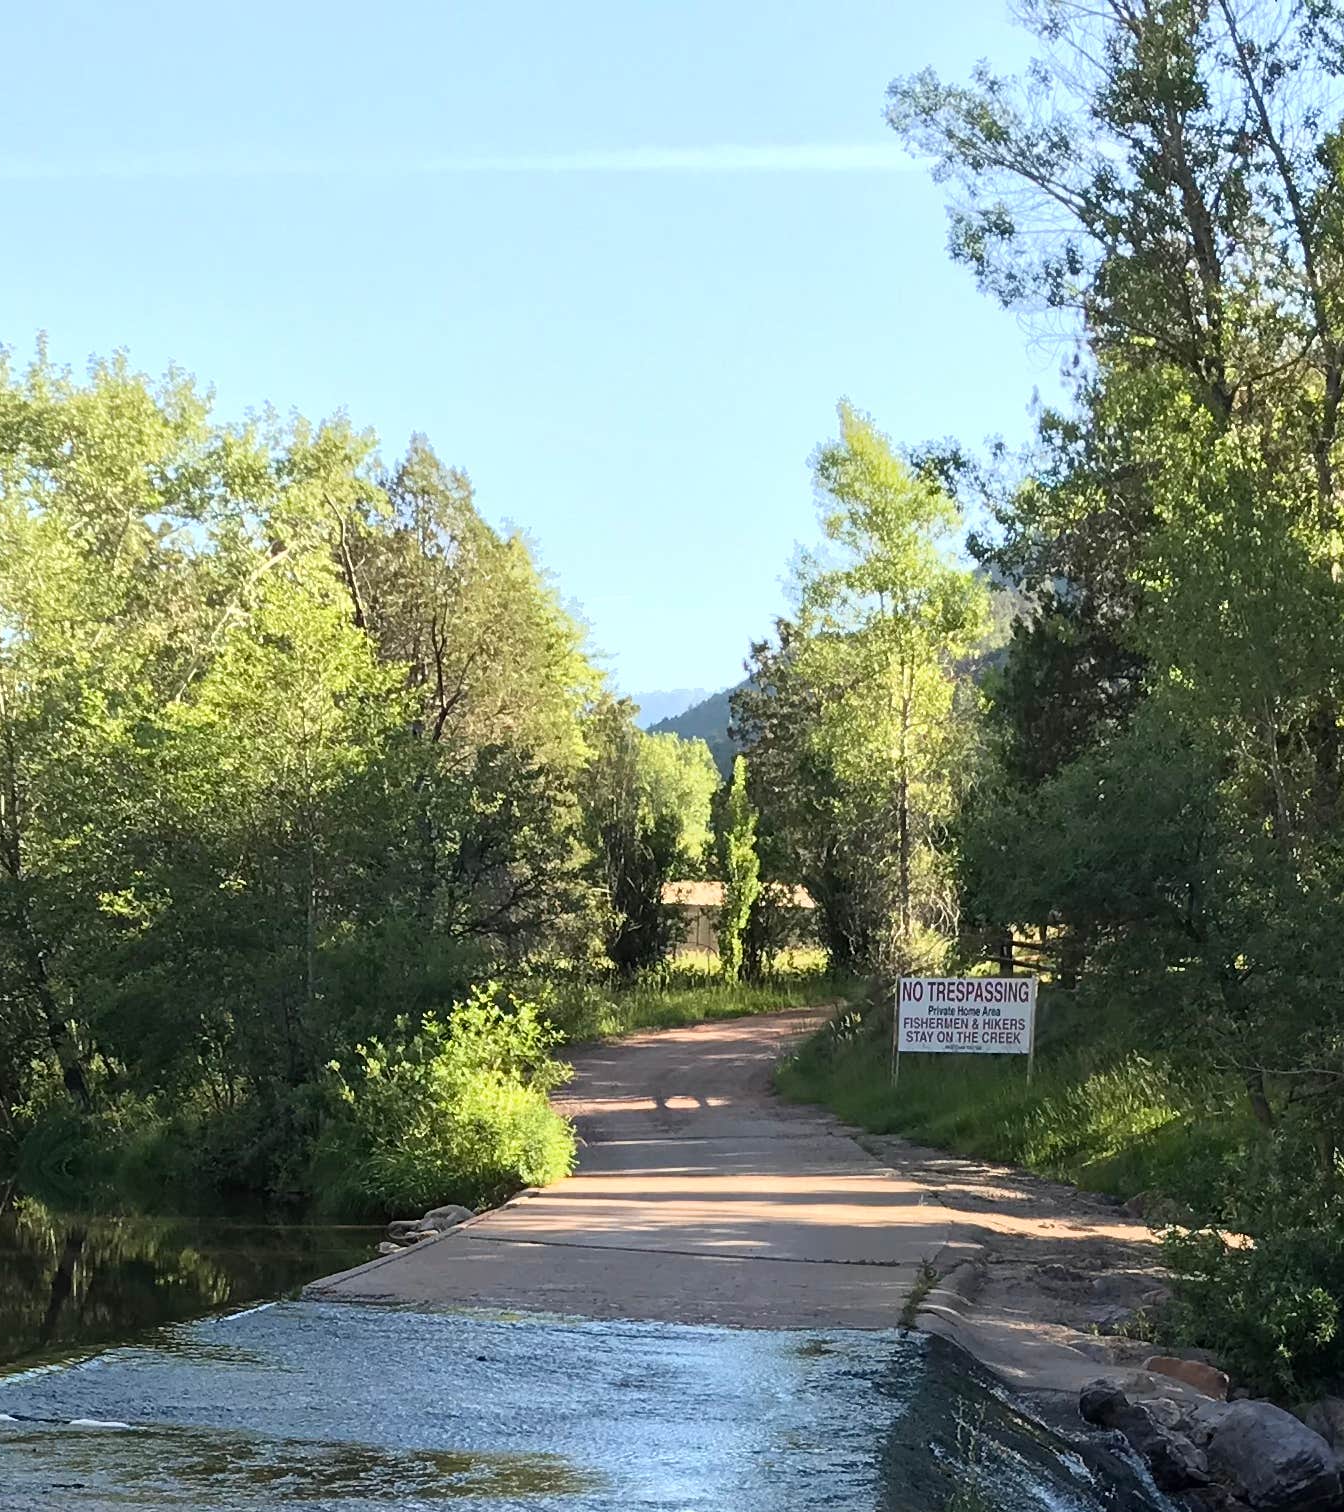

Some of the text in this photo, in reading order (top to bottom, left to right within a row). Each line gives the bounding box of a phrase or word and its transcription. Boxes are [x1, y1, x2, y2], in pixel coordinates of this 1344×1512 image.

[902, 981, 1029, 1003] NO TRESPASSING
[928, 1005, 1001, 1016] Private Home Area
[903, 1017, 1025, 1030] FISHERMEN & HIKERS
[906, 1030, 1021, 1044] STAY ON THE CREEK
